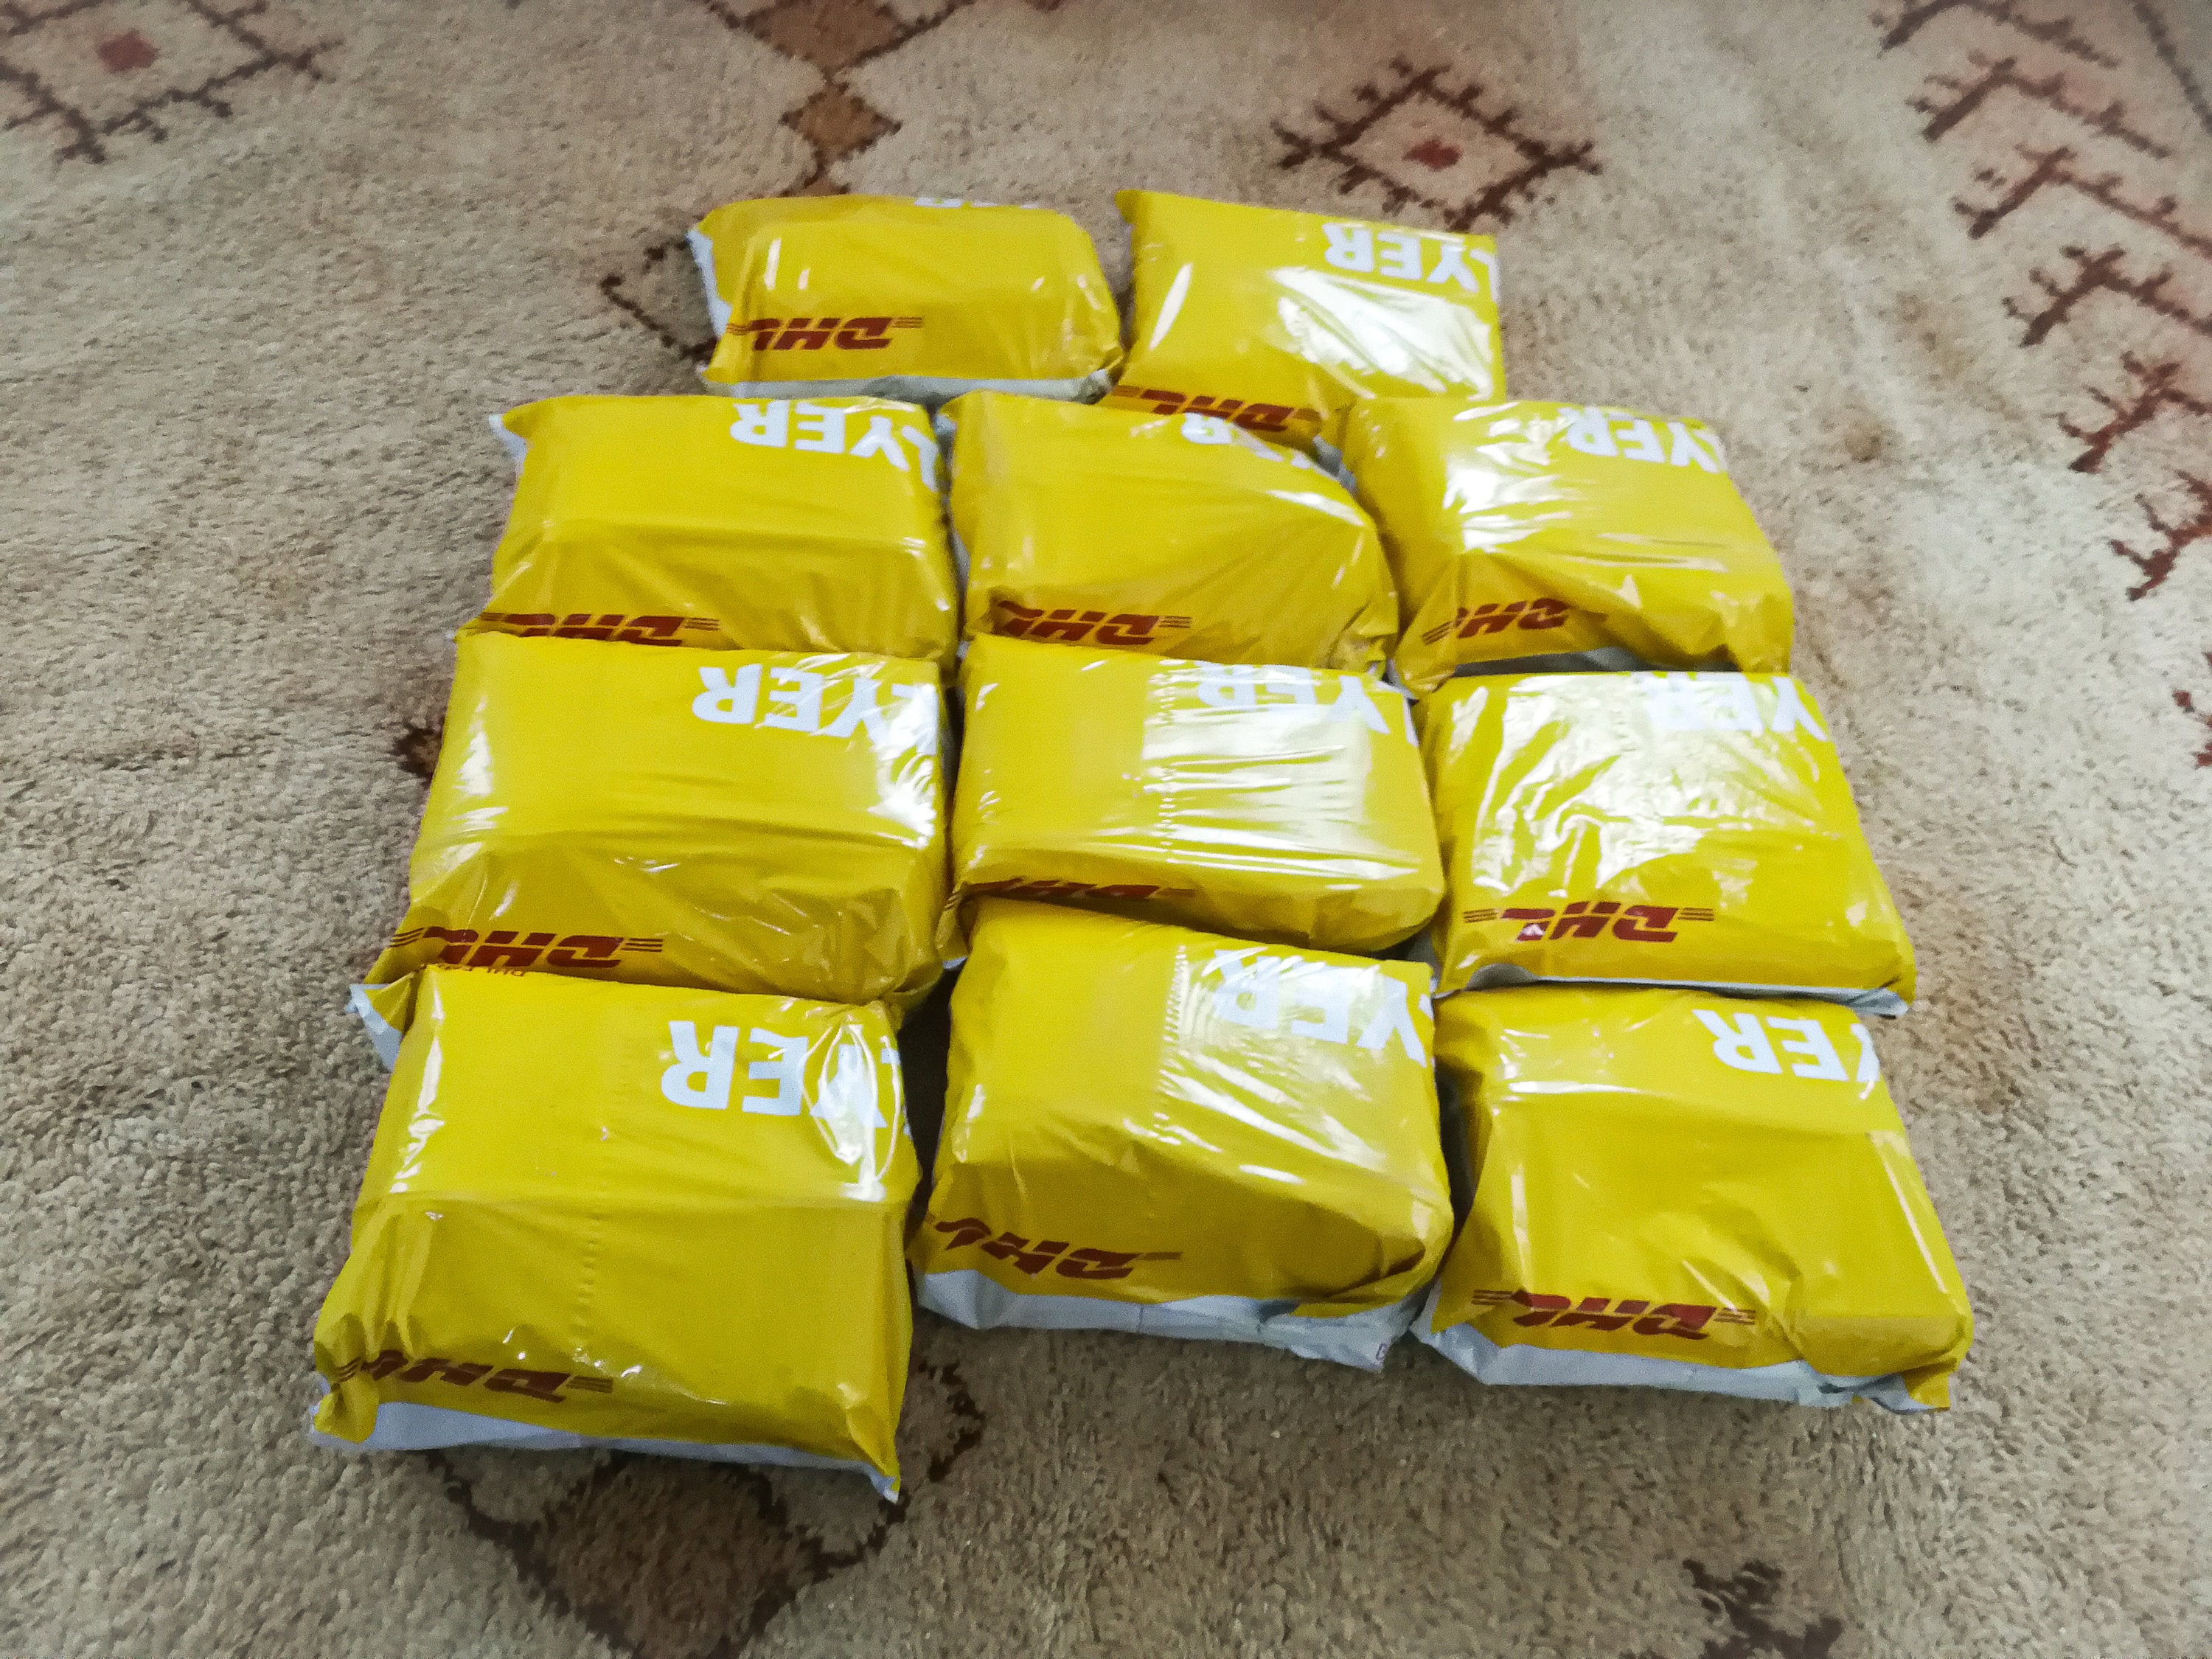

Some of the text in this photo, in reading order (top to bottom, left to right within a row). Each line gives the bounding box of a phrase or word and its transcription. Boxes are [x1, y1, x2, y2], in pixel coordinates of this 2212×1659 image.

[730, 399, 939, 493] LYER
[423, 927, 625, 969] DHL
[1502, 901, 1680, 942] DHL
[1213, 949, 1433, 1068] YER
[661, 1020, 911, 1136] YER
[935, 1217, 1143, 1280] DHL
[1512, 1289, 1717, 1340] DHL
